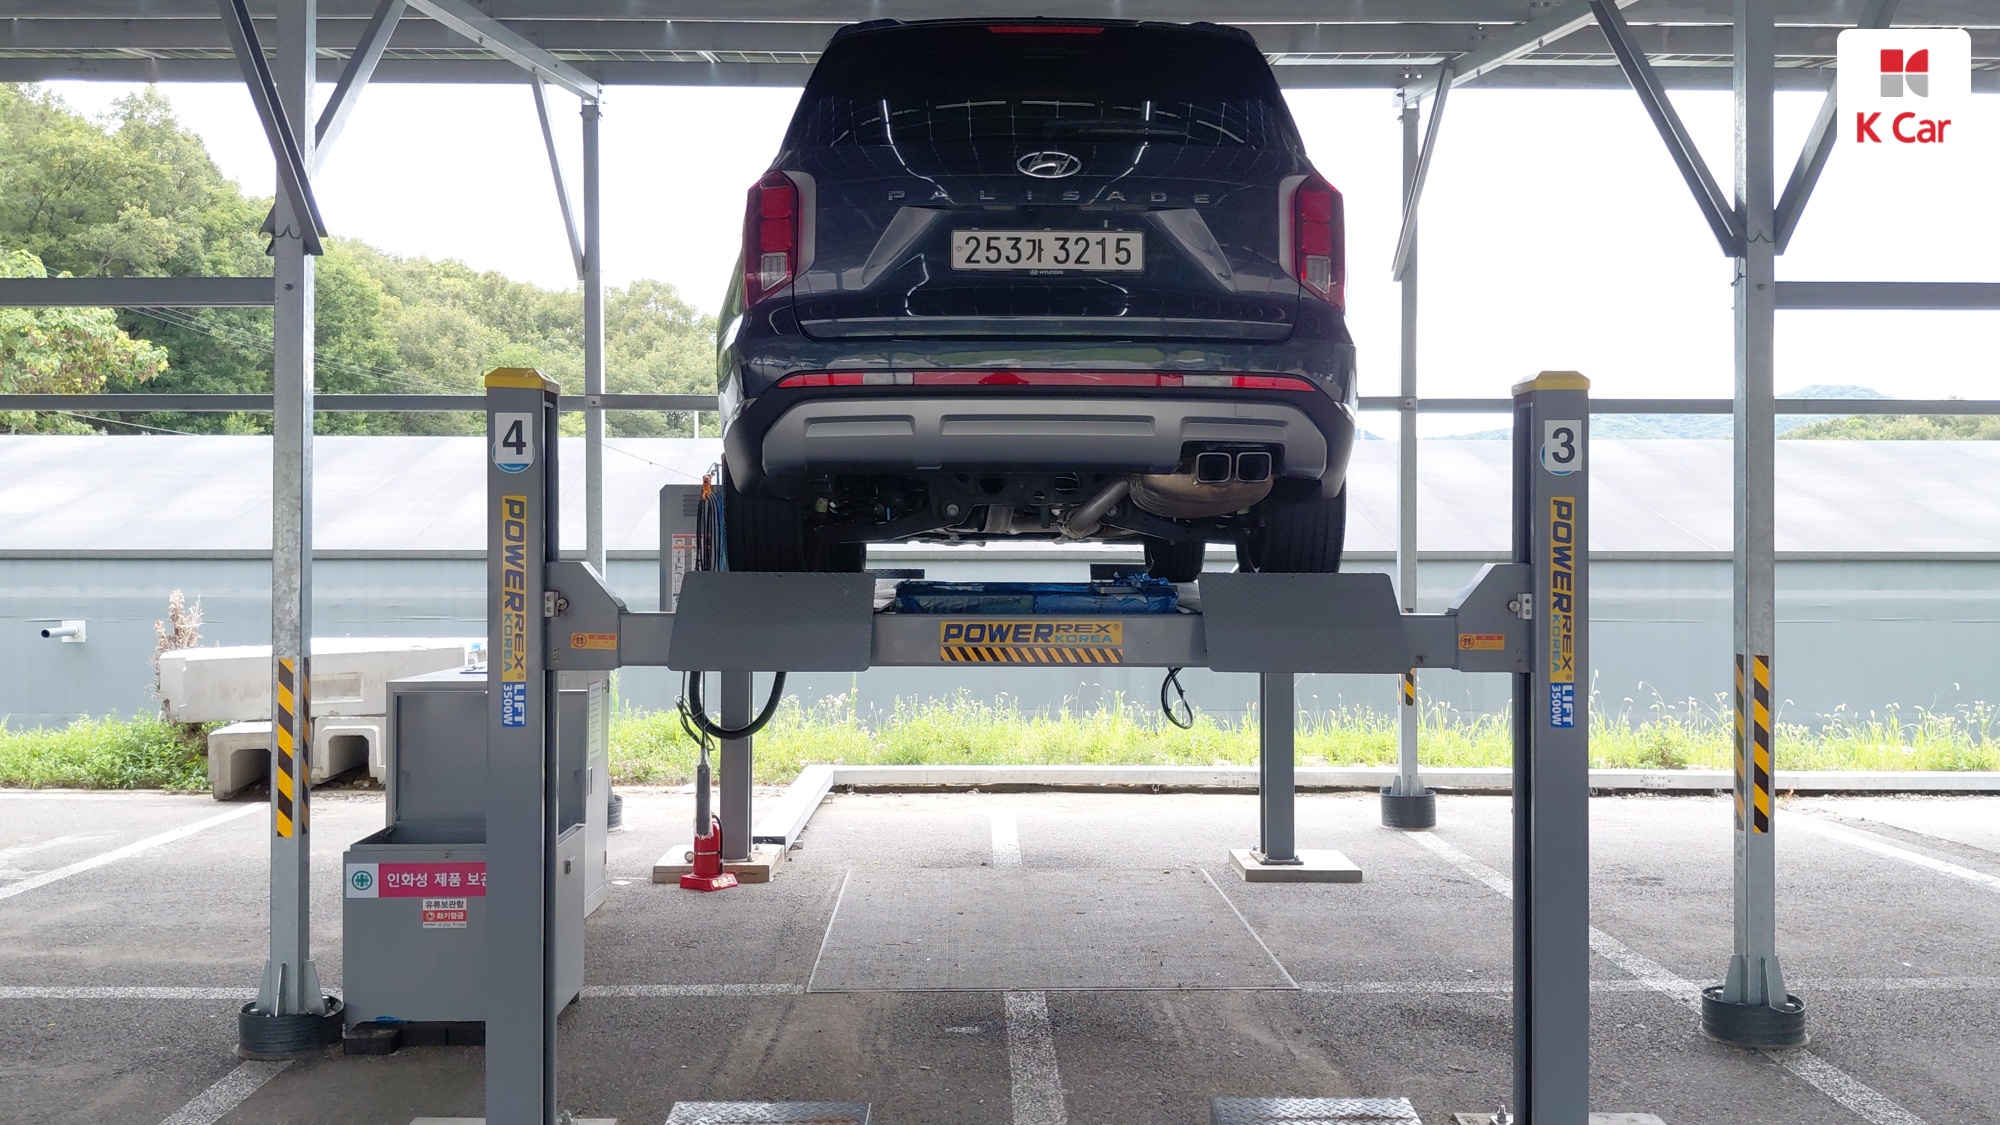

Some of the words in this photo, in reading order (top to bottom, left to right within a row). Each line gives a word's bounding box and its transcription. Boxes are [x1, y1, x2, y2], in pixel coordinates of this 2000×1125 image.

[888, 190, 1210, 204] PALISADE
[964, 236, 1045, 264] 253가
[1053, 237, 1132, 265] 3215
[502, 419, 526, 455] 4
[1552, 427, 1575, 463] 3
[505, 498, 525, 612] POWER
[1552, 499, 1572, 611] POWER
[504, 613, 513, 673] KOREA
[943, 623, 1054, 643] POWER
[1055, 635, 1112, 643] KOREA
[1552, 614, 1561, 673] KOREA
[503, 684, 513, 725] 3500W
[514, 684, 525, 725] LIFT
[1552, 685, 1561, 726] 3500W
[1562, 685, 1573, 726] LIFT
[387, 872, 428, 888] 인화성
[434, 872, 462, 887] 제품
[425, 900, 464, 909] 유류보관함
